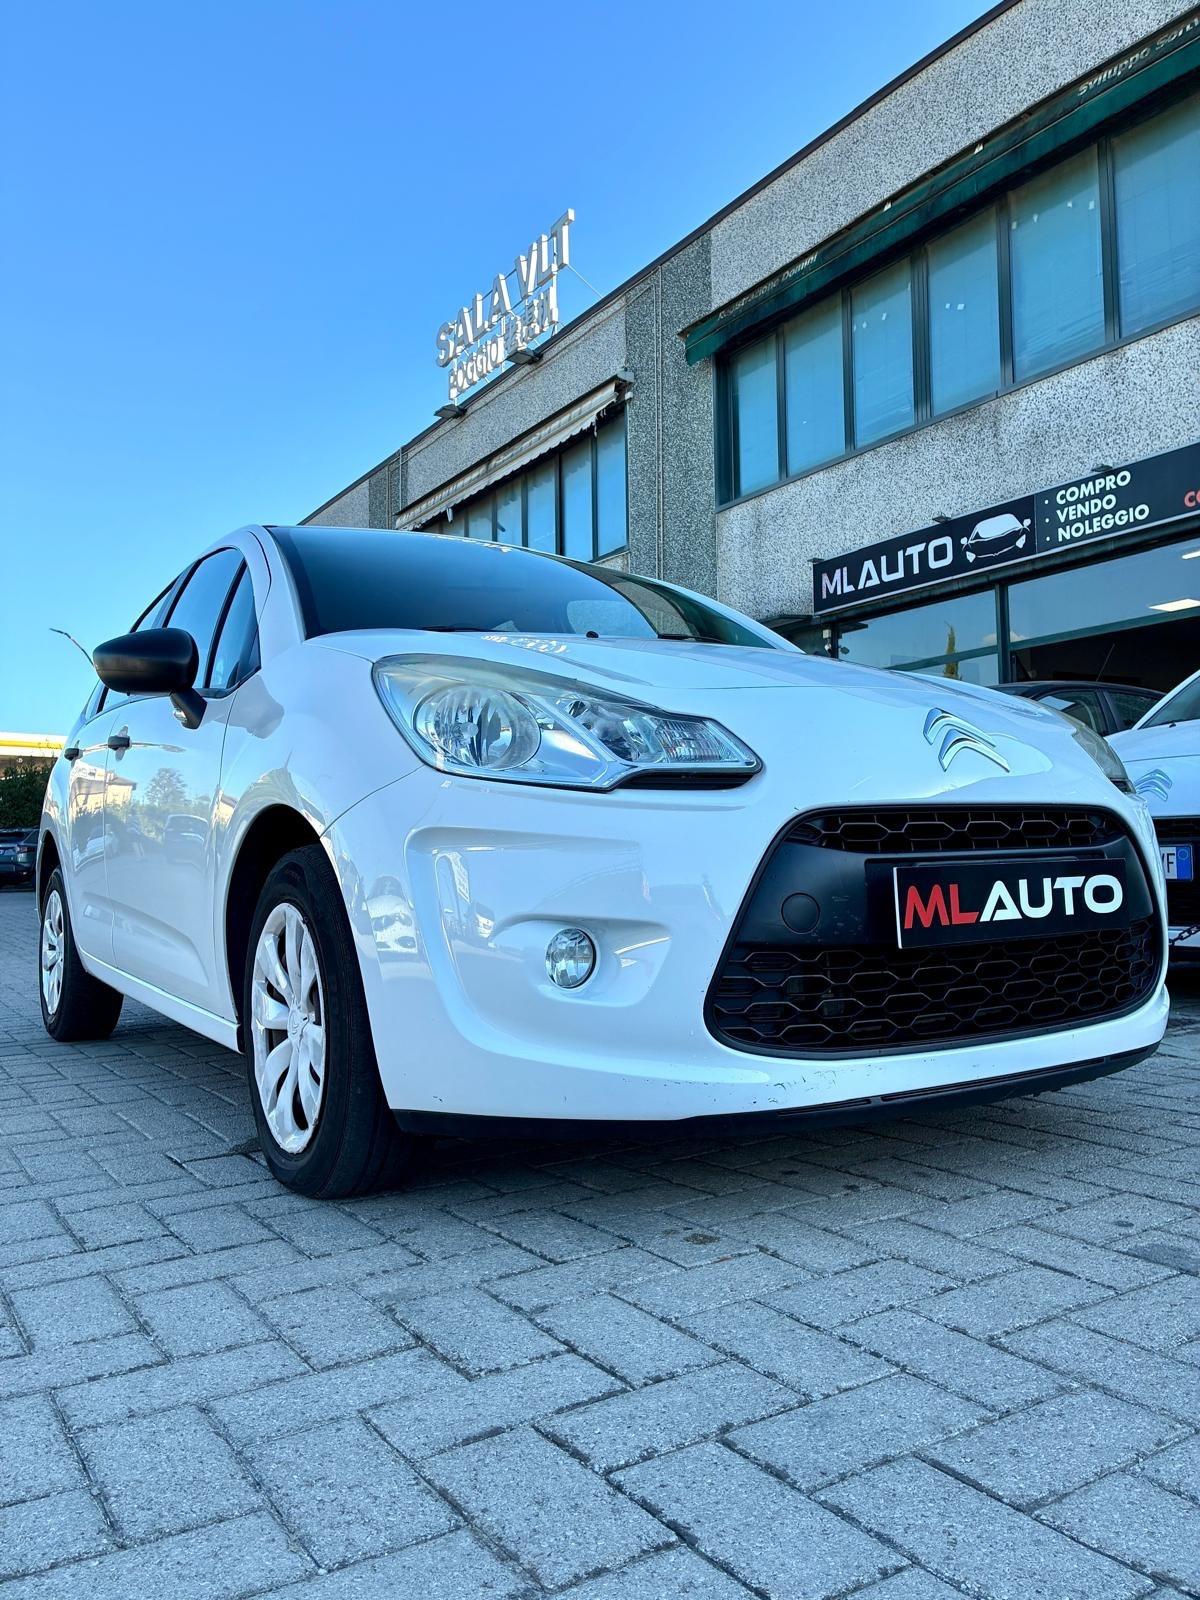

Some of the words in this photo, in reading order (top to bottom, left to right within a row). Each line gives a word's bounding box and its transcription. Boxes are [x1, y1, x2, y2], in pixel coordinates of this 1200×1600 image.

[1077, 46, 1151, 97] Sviluppo
[436, 272, 512, 368] SALA
[449, 334, 505, 401] POGGIO
[1056, 469, 1132, 506] COMPRO
[1056, 493, 1117, 524] VENDO
[1057, 503, 1150, 543] NOLEGGIO
